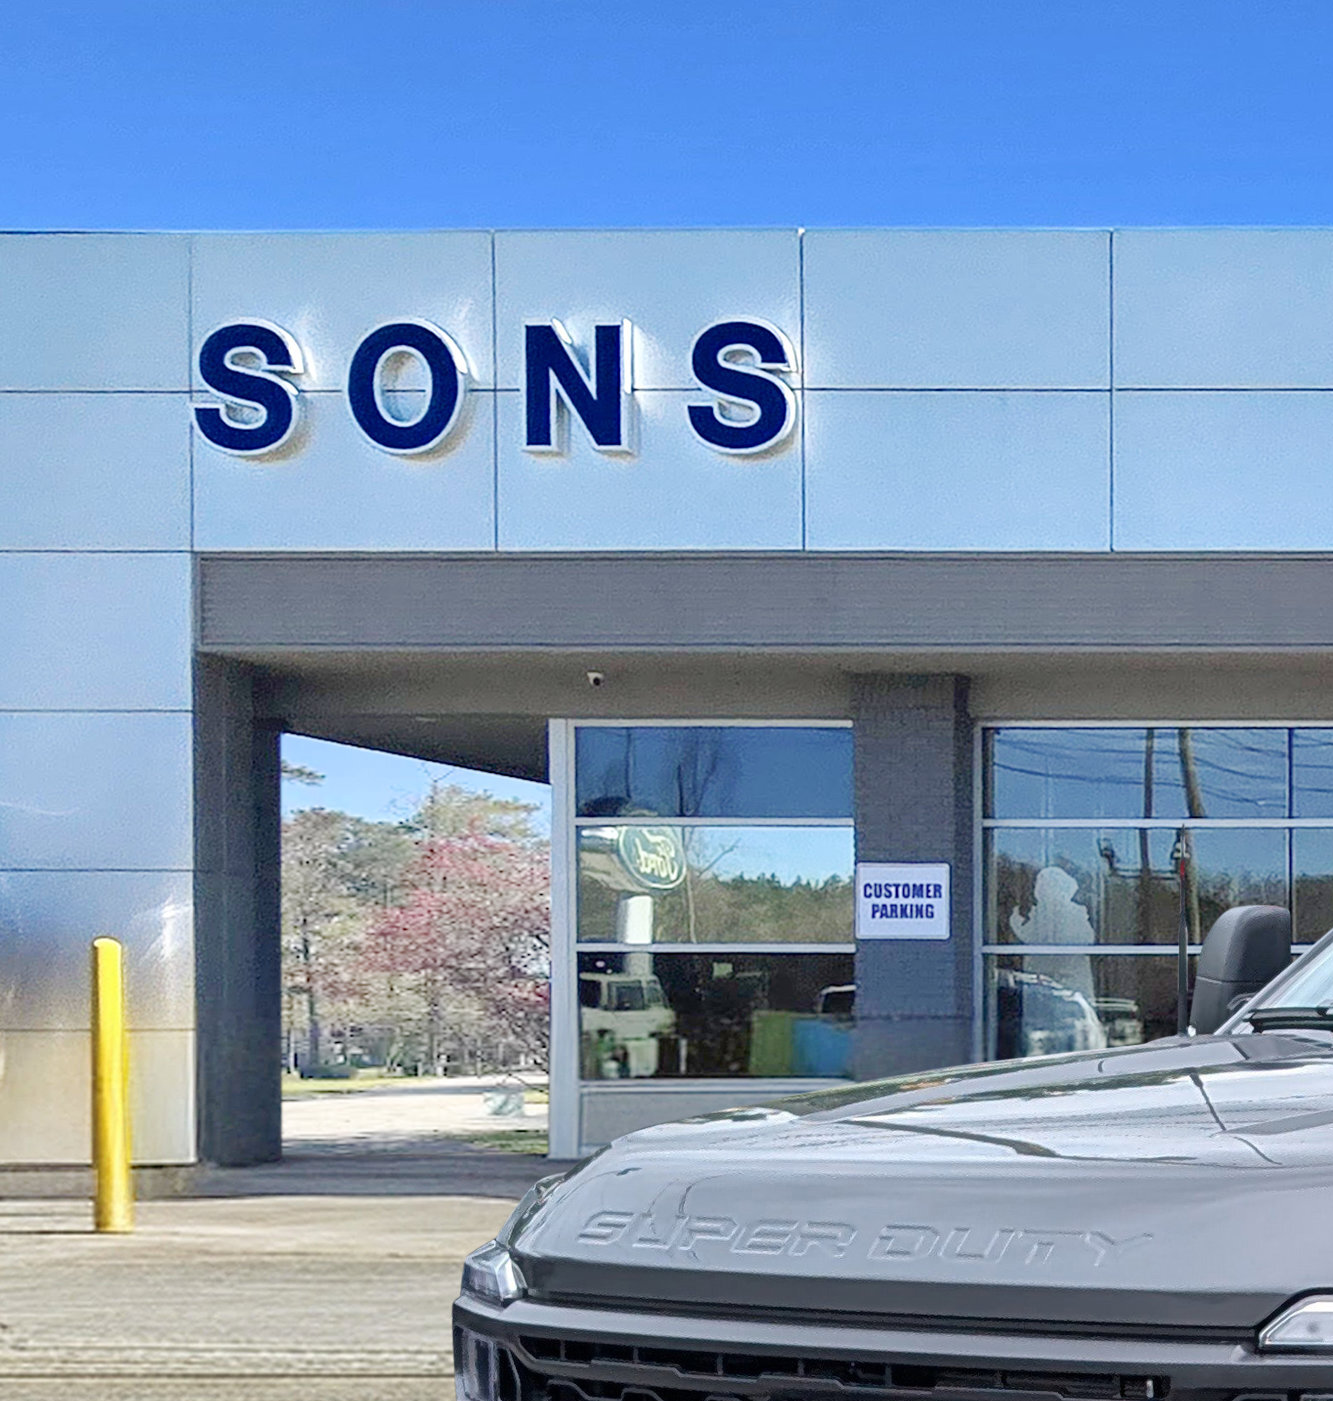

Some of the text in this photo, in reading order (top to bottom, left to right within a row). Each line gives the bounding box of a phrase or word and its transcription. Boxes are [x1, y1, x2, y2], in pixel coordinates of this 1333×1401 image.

[192, 319, 798, 455] SONS
[863, 882, 943, 899] CUSTOMER
[871, 903, 935, 919] PARKING
[577, 1210, 1154, 1267] SUPER DUTY
